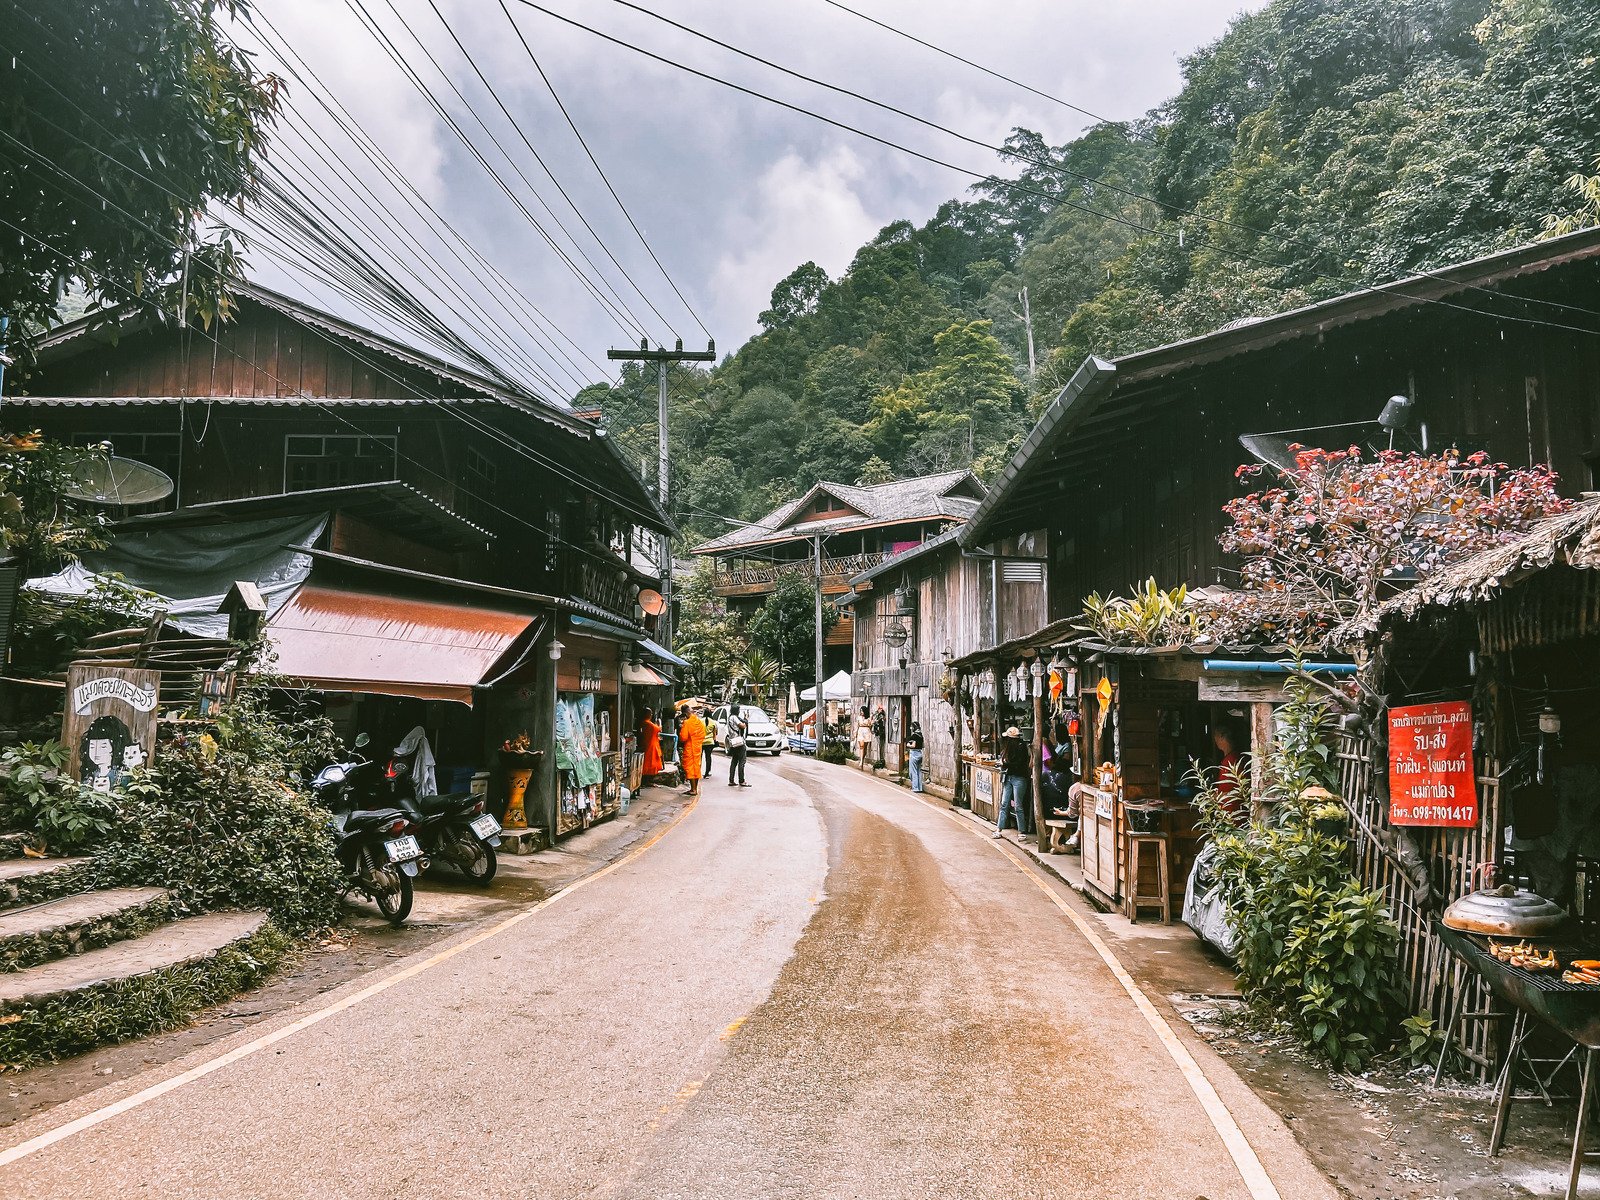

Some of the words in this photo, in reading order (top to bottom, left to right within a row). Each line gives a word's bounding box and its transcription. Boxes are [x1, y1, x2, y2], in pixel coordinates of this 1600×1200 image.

[1413, 727, 1446, 750] รับ-ส่ง
[1396, 752, 1421, 774] กิ่วฝิ่น
